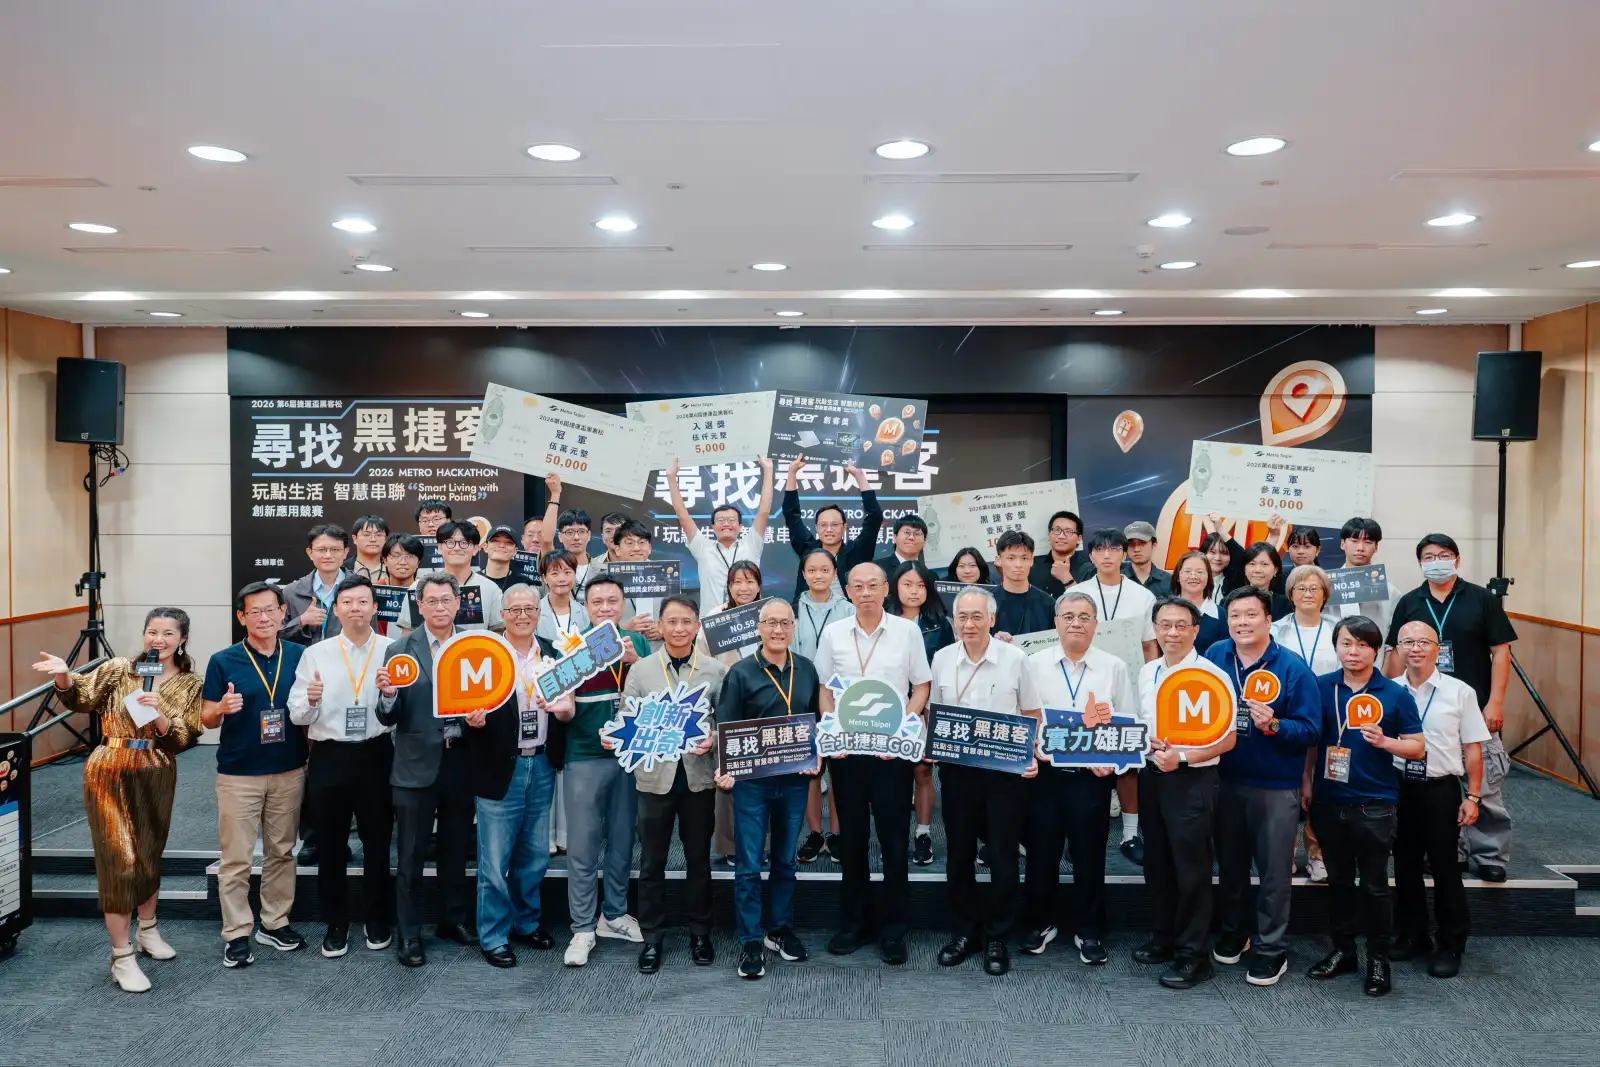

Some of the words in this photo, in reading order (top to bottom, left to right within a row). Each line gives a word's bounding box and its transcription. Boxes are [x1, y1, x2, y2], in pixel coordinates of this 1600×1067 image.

[251, 400, 274, 408] 2026
[789, 412, 818, 423] acer
[555, 429, 588, 445] 冠軍
[251, 422, 343, 468] 尋找
[549, 441, 589, 459] 伍萬元整
[695, 442, 725, 455] 5,000
[545, 453, 588, 472] 50,000
[368, 468, 394, 477] 2026
[398, 468, 432, 477] METRO
[436, 468, 499, 477] HACKATHON
[1265, 473, 1299, 484] 亞軍
[251, 482, 324, 501] 玩點生活
[333, 482, 405, 501] 智慧串聯
[448, 483, 477, 494] Living
[479, 483, 499, 492] with
[654, 460, 761, 510] 尋找
[418, 492, 446, 501] Metro
[1259, 497, 1303, 510] 30,000
[251, 504, 324, 518] 創新應用競賽
[632, 575, 657, 583] NO.52
[1333, 580, 1360, 590] NO.58
[386, 599, 402, 608] NO.
[729, 619, 756, 633] NO.59
[395, 663, 409, 678] M
[460, 657, 492, 691] M
[1254, 678, 1270, 695] M
[1178, 689, 1210, 724] M
[1357, 703, 1372, 718] M
[635, 700, 691, 729] 創新
[848, 718, 869, 726] Metro
[871, 719, 891, 728] Taipei
[933, 719, 971, 742] 尋找
[973, 719, 1029, 745] 黑捷客
[1045, 726, 1145, 752] 實力雄厚
[629, 727, 683, 755] 出奇
[725, 736, 759, 757] 尋找
[761, 724, 811, 747] 黑捷客
[820, 731, 920, 759] 台北捷運GO!
